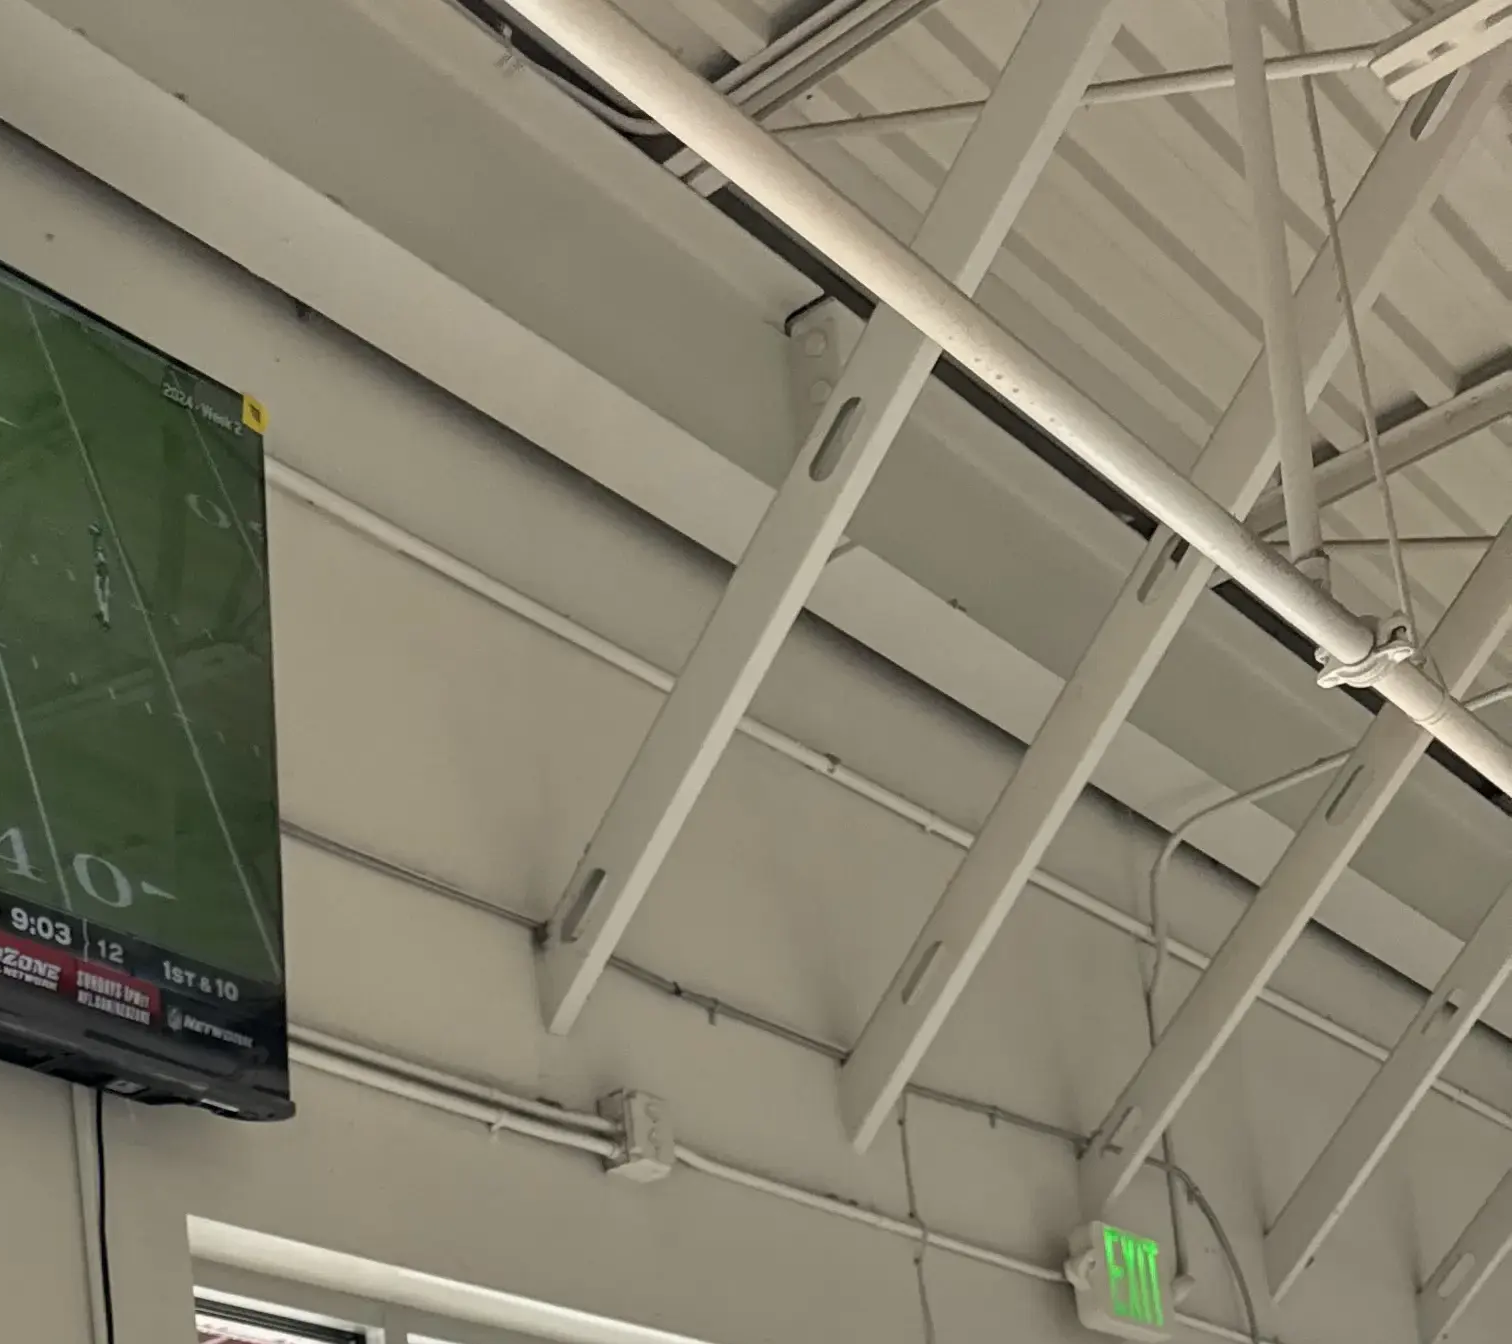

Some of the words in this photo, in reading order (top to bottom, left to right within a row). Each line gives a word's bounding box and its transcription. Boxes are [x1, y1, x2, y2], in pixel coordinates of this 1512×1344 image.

[10, 907, 73, 946] 9:03
[97, 938, 125, 964] 12
[163, 960, 197, 988] 1ST
[199, 976, 212, 993] &
[215, 978, 239, 1002] 10
[1103, 1227, 1165, 1327] EXIT
